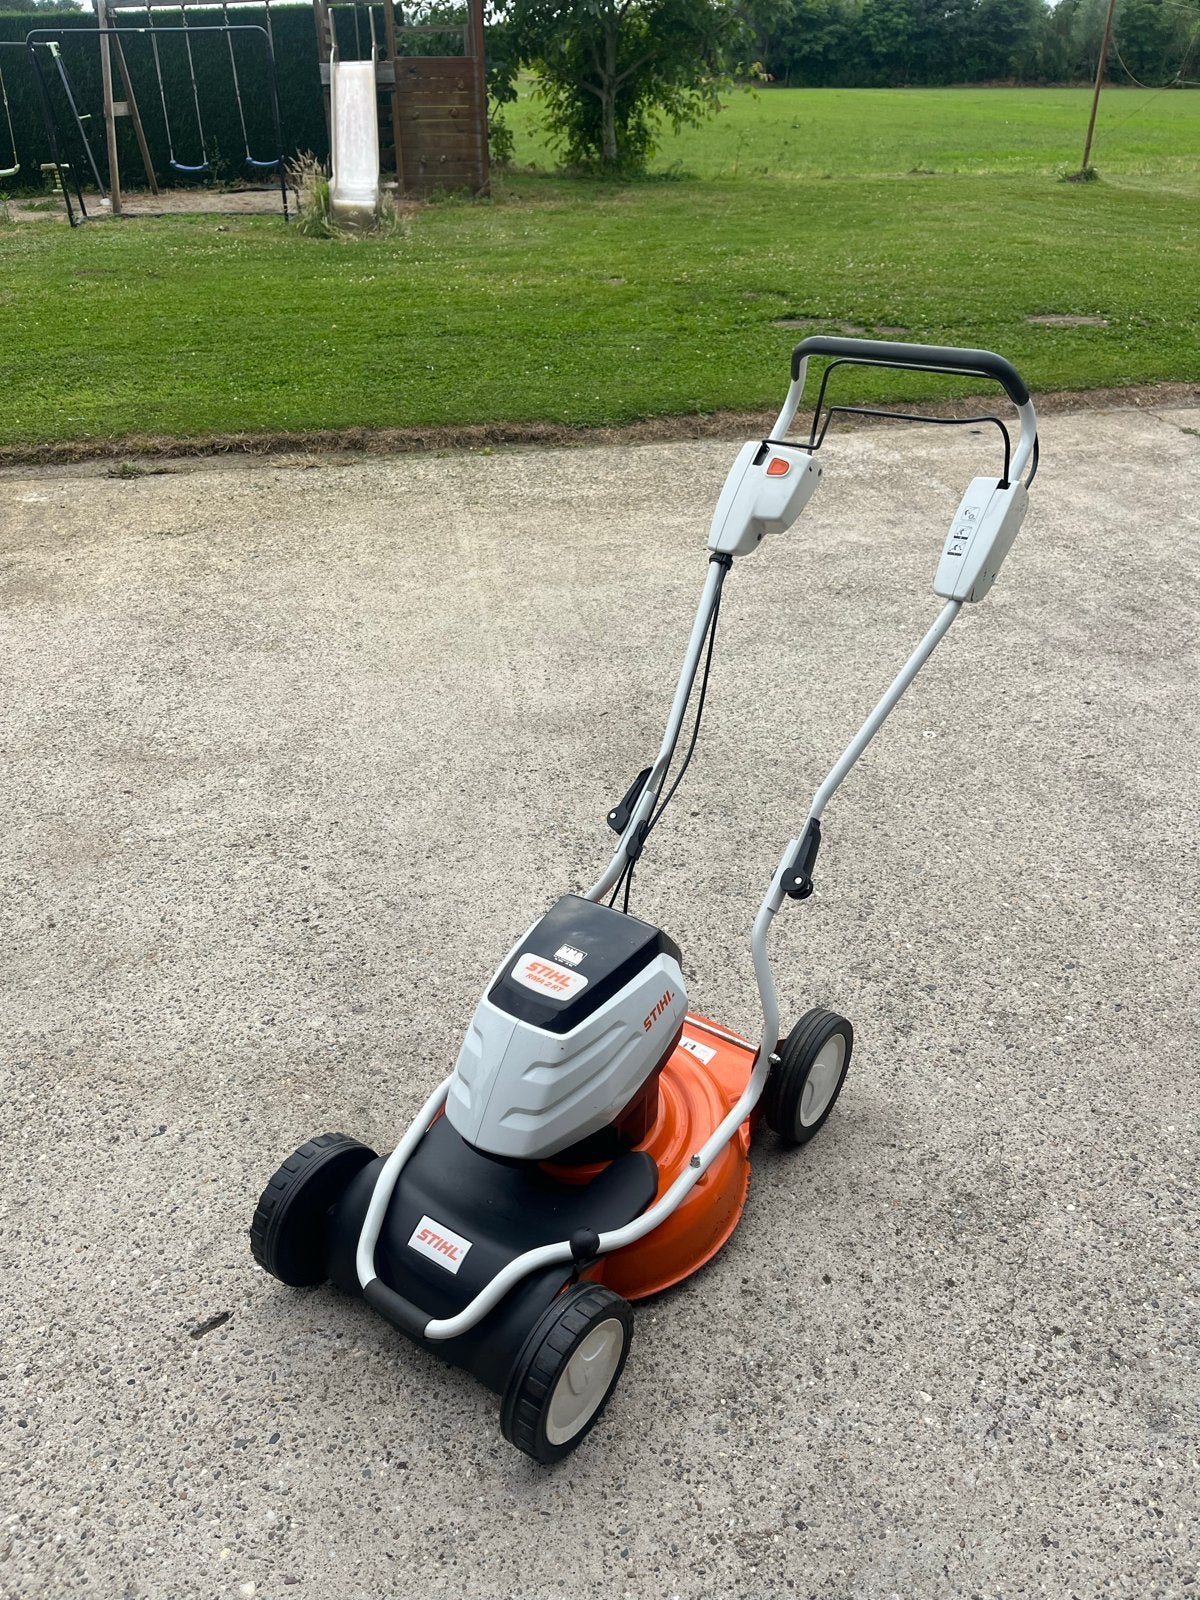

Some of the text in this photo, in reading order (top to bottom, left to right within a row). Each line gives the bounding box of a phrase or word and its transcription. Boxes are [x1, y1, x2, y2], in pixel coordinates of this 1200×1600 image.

[525, 961, 571, 988] STIHL
[526, 973, 545, 984] RMA
[550, 984, 565, 992] RT
[643, 990, 672, 1032] STIHL
[416, 1228, 459, 1261] STIHL
